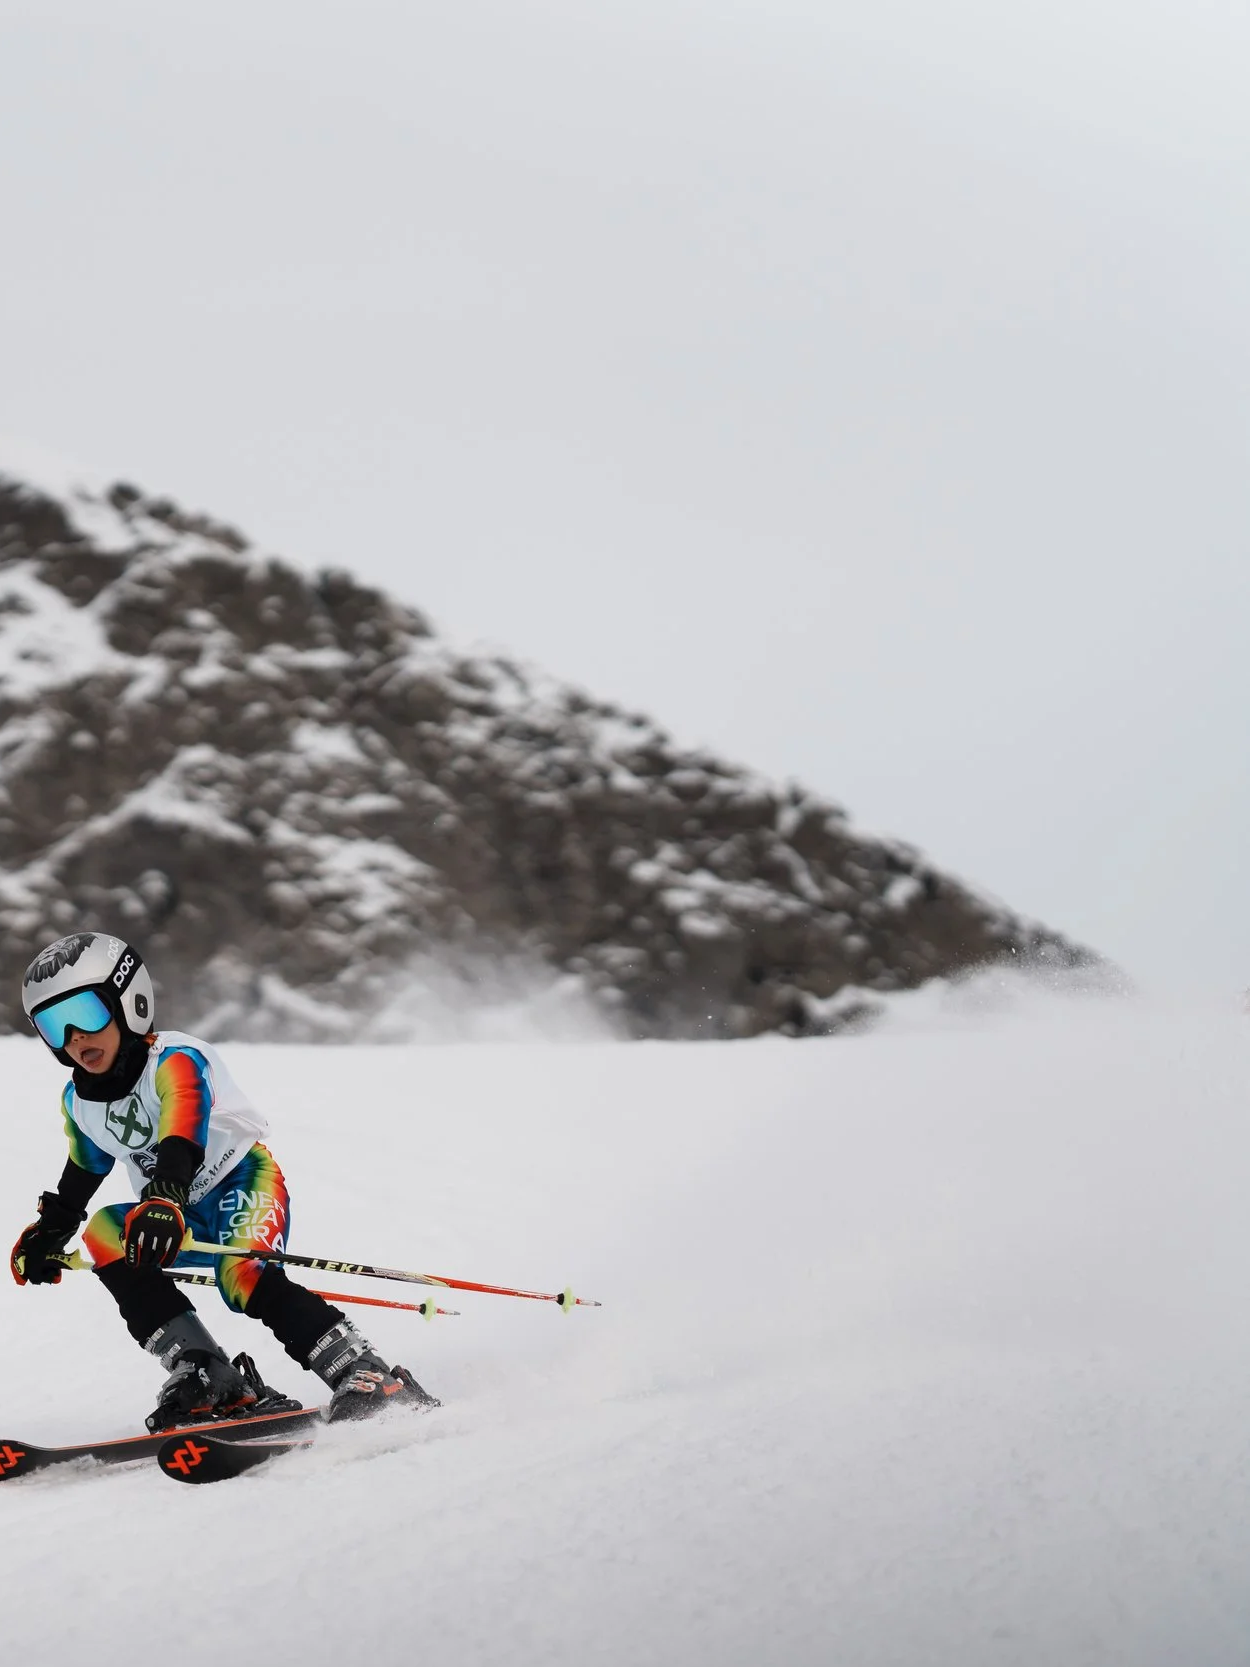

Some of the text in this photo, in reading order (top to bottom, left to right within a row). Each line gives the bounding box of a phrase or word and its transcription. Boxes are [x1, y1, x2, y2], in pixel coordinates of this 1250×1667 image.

[187, 1177, 210, 1193] asse
[218, 1189, 286, 1222] ENER
[147, 1211, 173, 1221] LEKI
[228, 1209, 278, 1228] GIA
[218, 1225, 285, 1255] PURA
[309, 1259, 364, 1275] LEKI
[191, 1274, 216, 1286] LE
